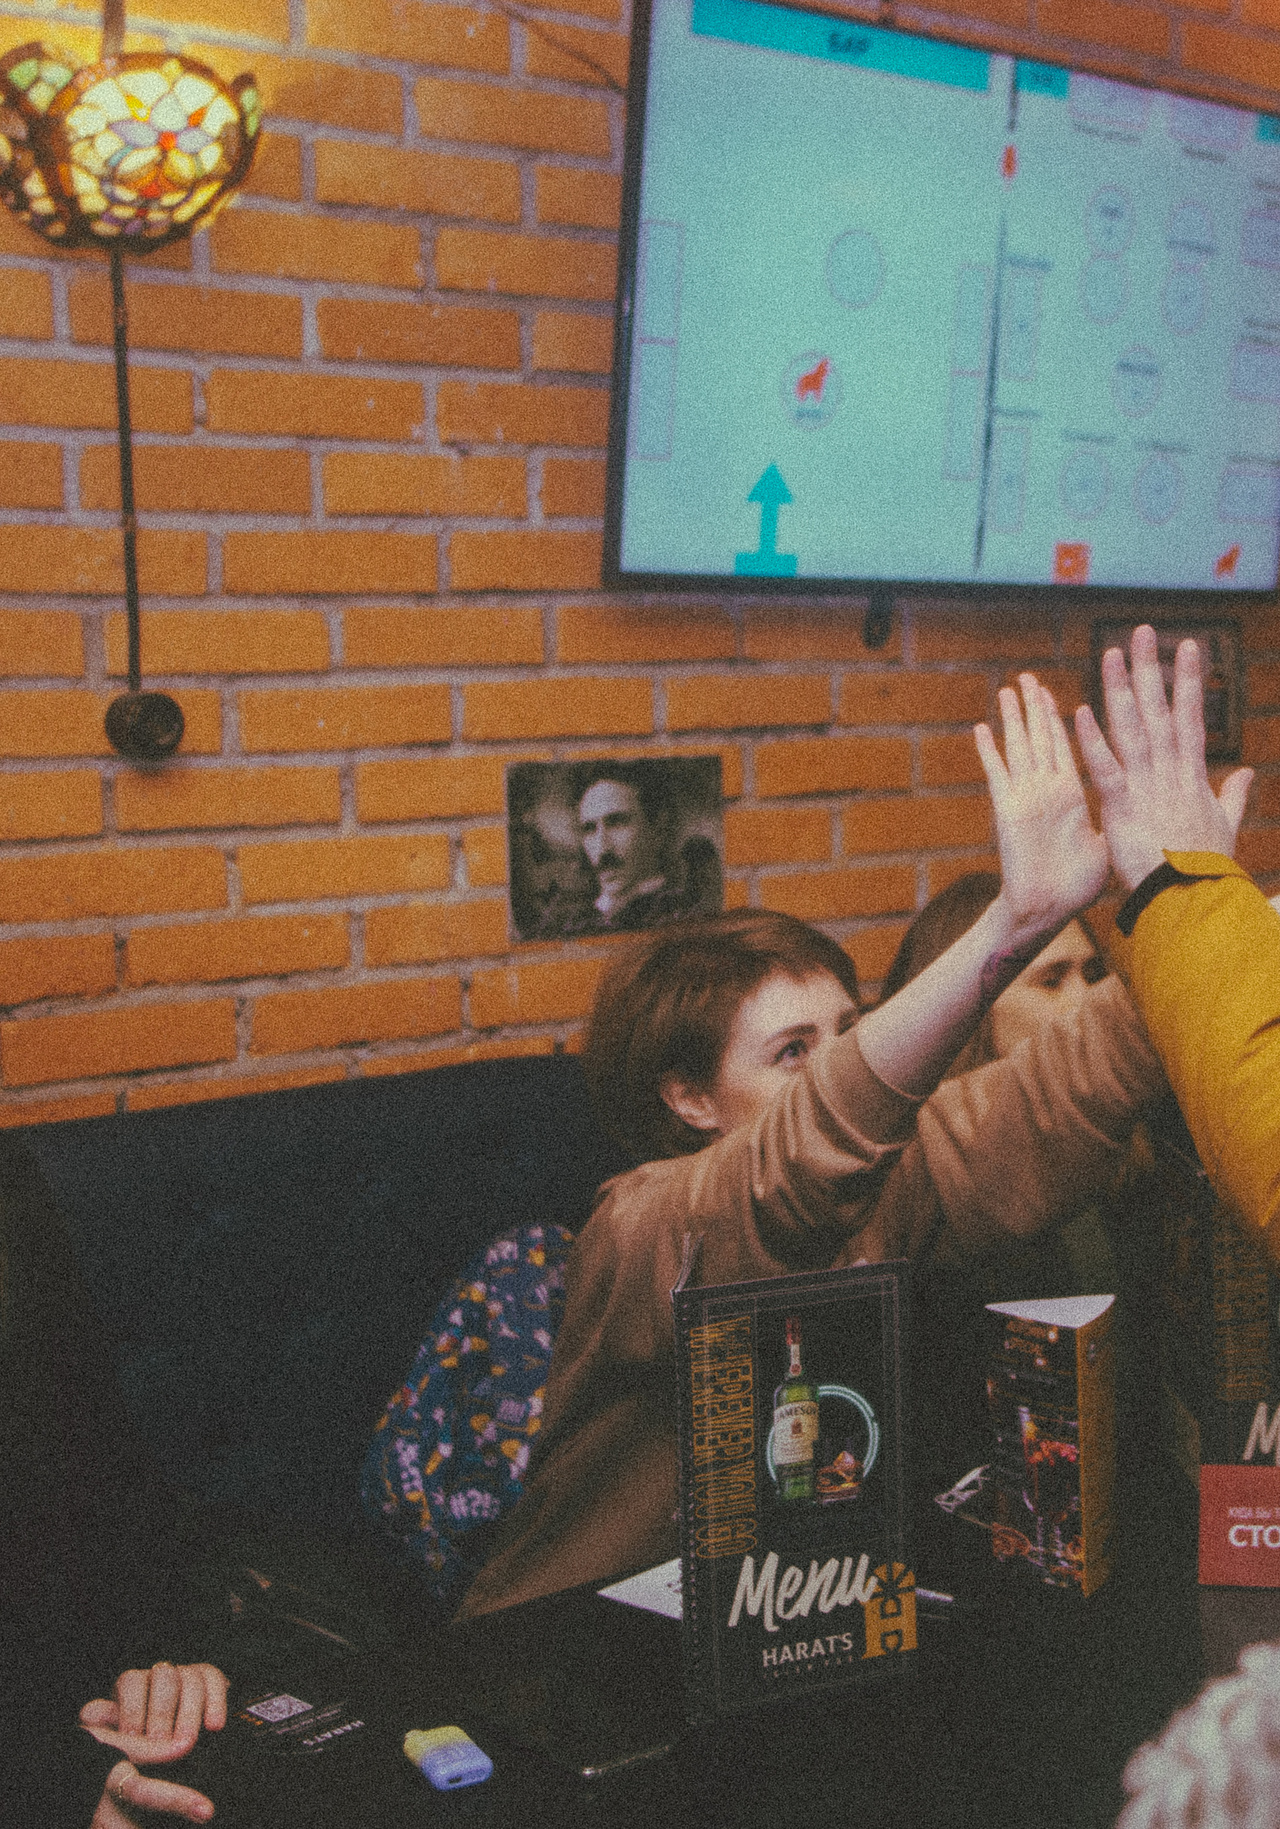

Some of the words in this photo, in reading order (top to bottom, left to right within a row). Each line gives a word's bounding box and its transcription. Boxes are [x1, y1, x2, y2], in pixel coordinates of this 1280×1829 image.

[694, 1460, 757, 1519] YOU
[696, 1517, 758, 1560] GO
[728, 1551, 878, 1633] Menu
